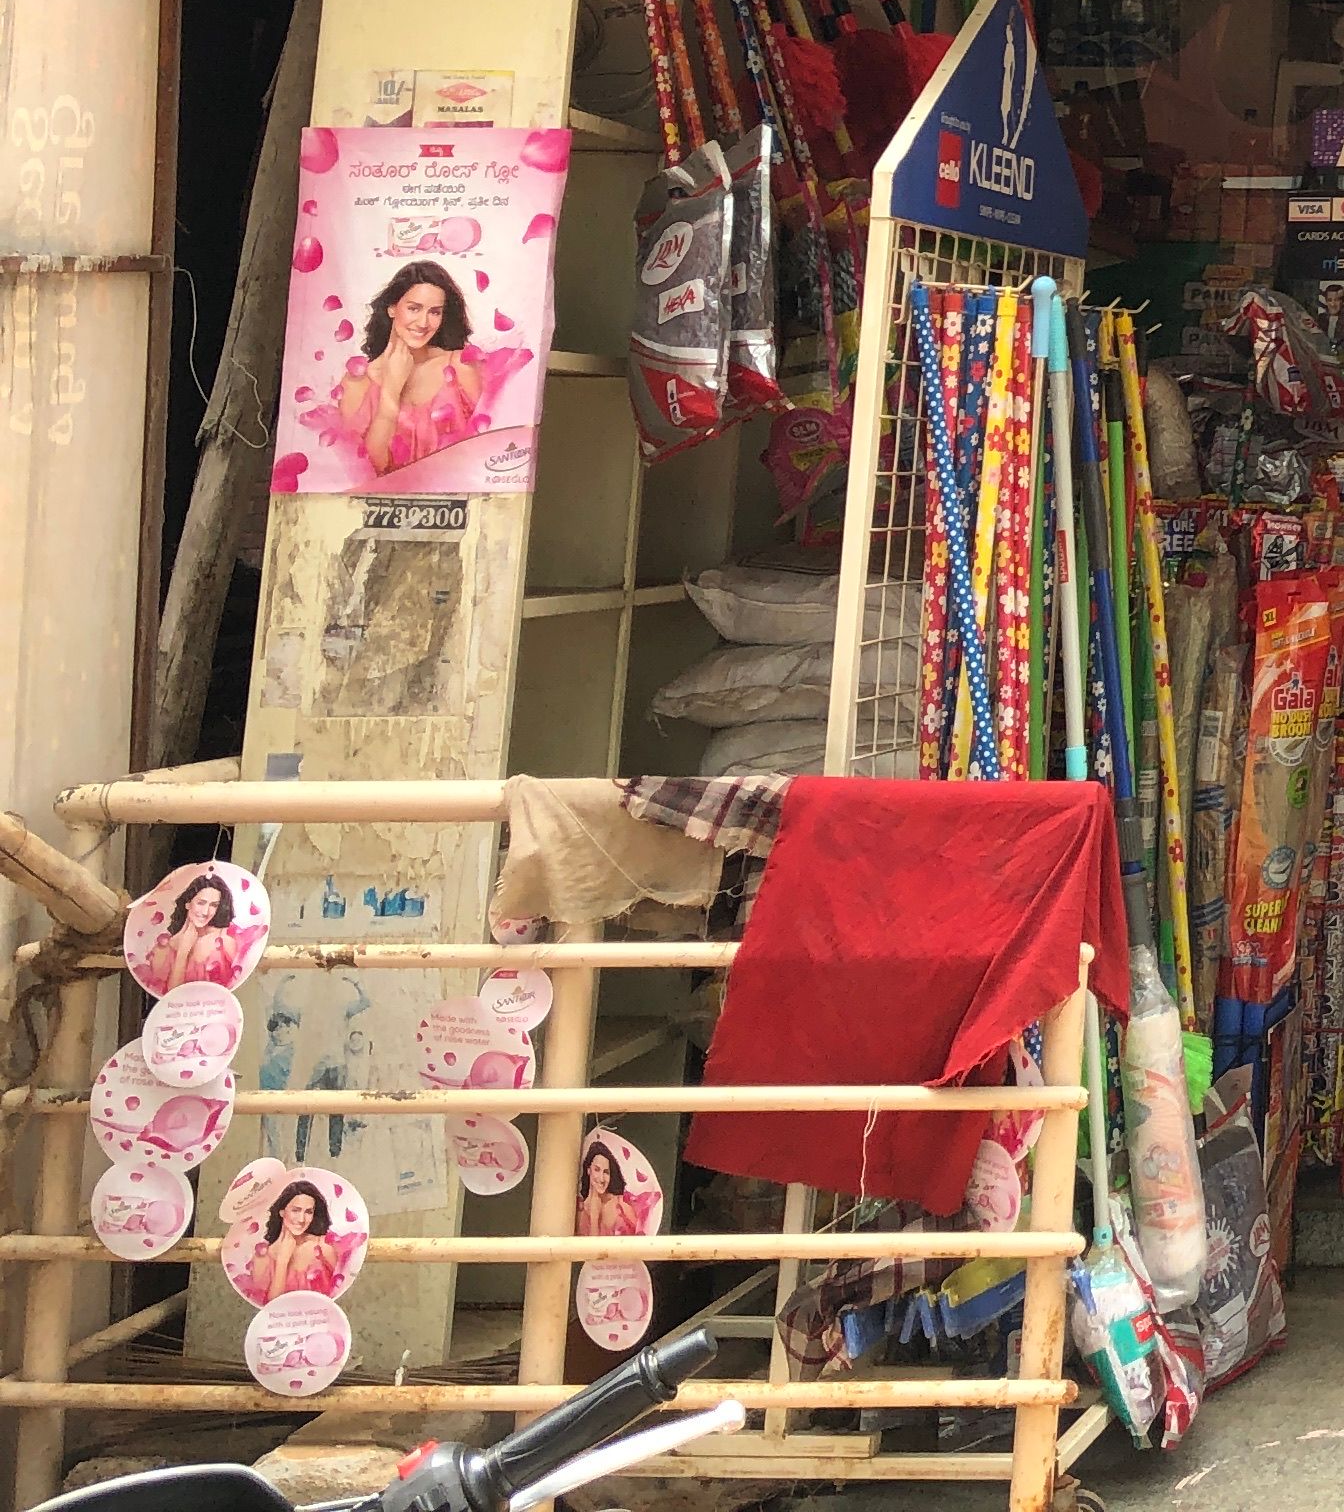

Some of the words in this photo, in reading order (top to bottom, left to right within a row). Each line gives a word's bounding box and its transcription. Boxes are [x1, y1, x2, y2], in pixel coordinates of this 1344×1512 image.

[437, 105, 484, 113] MASALAS
[349, 161, 419, 179] ಸಂತೂರ್
[969, 138, 1035, 201] KLEENO
[1298, 205, 1324, 215] VISA
[1297, 231, 1329, 241] CARDS
[1264, 610, 1275, 623] XL
[1272, 688, 1315, 711] Gala
[1271, 709, 1288, 724] NO
[1290, 708, 1312, 724] DUST
[1270, 723, 1313, 738] BROOM
[1244, 896, 1286, 918] SUPER
[430, 1013, 457, 1023] Made
[459, 1016, 477, 1024] with
[449, 1026, 491, 1038] goodness
